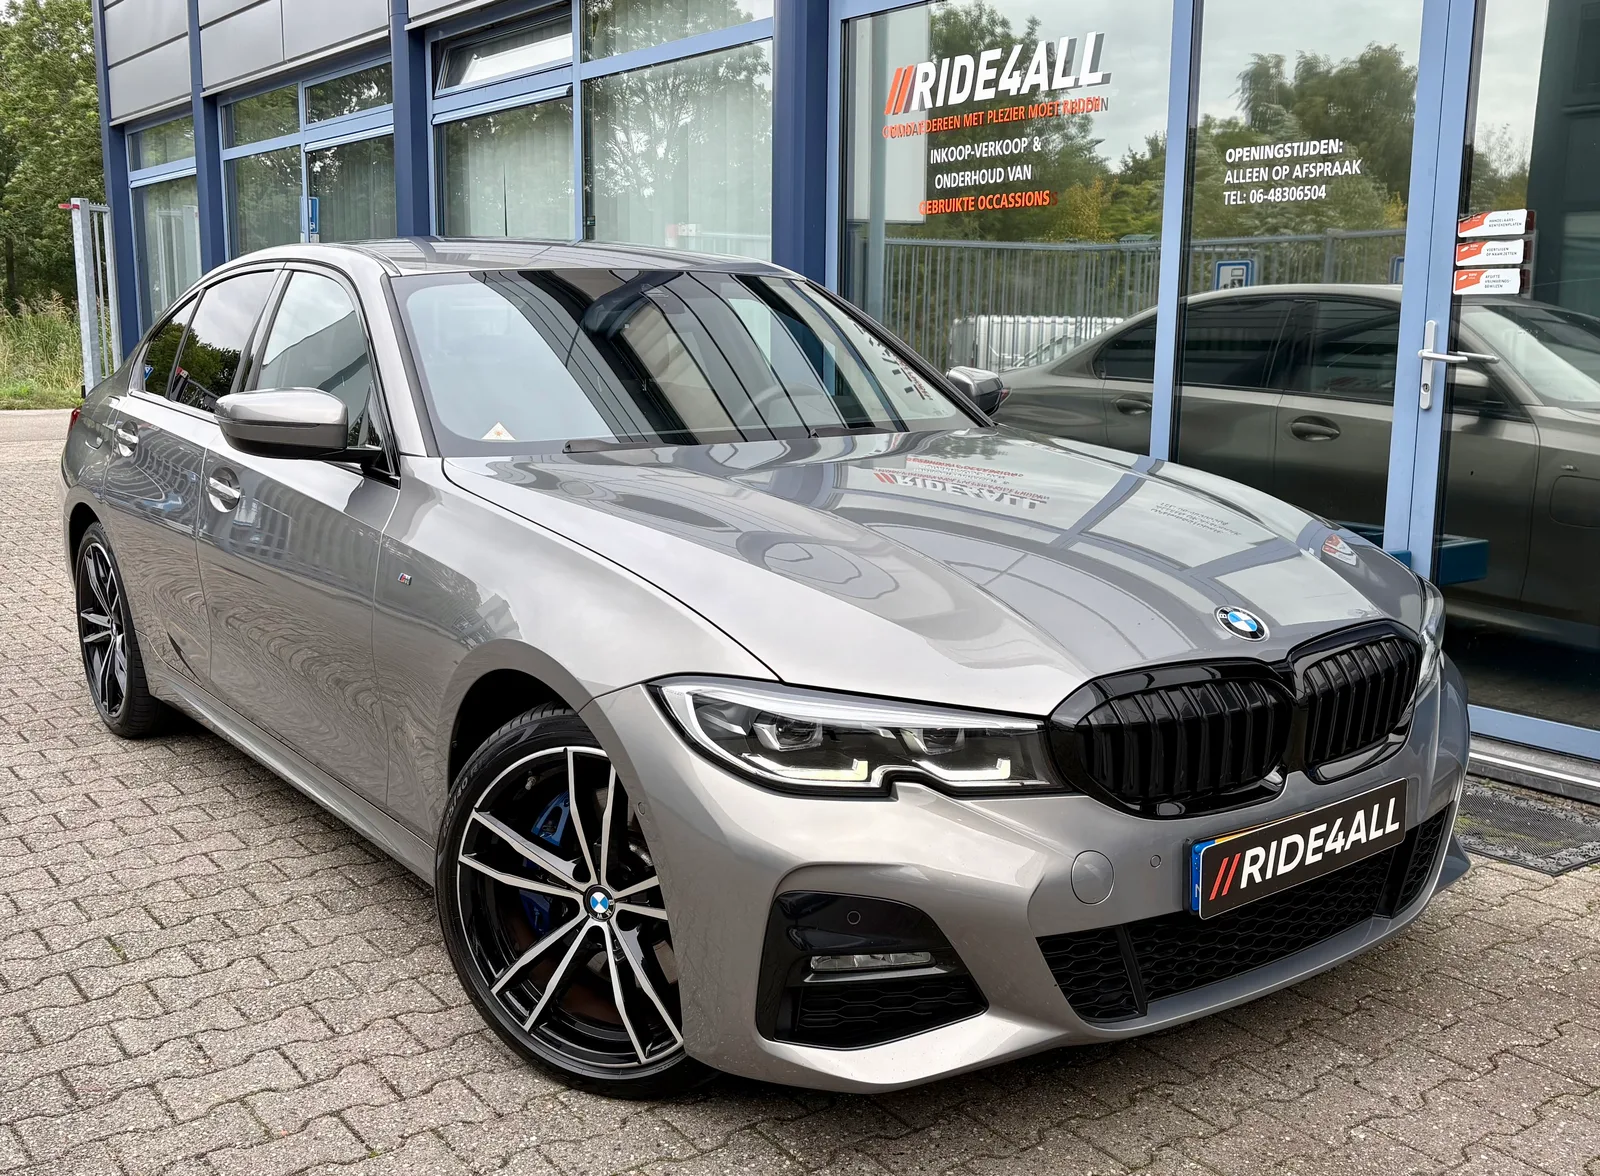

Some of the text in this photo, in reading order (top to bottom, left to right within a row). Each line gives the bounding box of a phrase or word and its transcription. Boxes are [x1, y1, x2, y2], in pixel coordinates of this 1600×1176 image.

[963, 111, 984, 127] MET
[987, 105, 1025, 124] PLEZIER
[1028, 100, 1060, 119] MOET
[930, 136, 1042, 164] INKOOP-VERKOOP &
[1225, 138, 1344, 163] OPENINGSTIJDEN:
[934, 164, 1032, 189] ONDERHOUD VAN
[1224, 159, 1362, 184] ALLEEN OP AFSPRAAK
[918, 190, 1050, 215] GEBRUIKTE OCCASSIONS
[1223, 184, 1327, 206] TEL: 06-48306504
